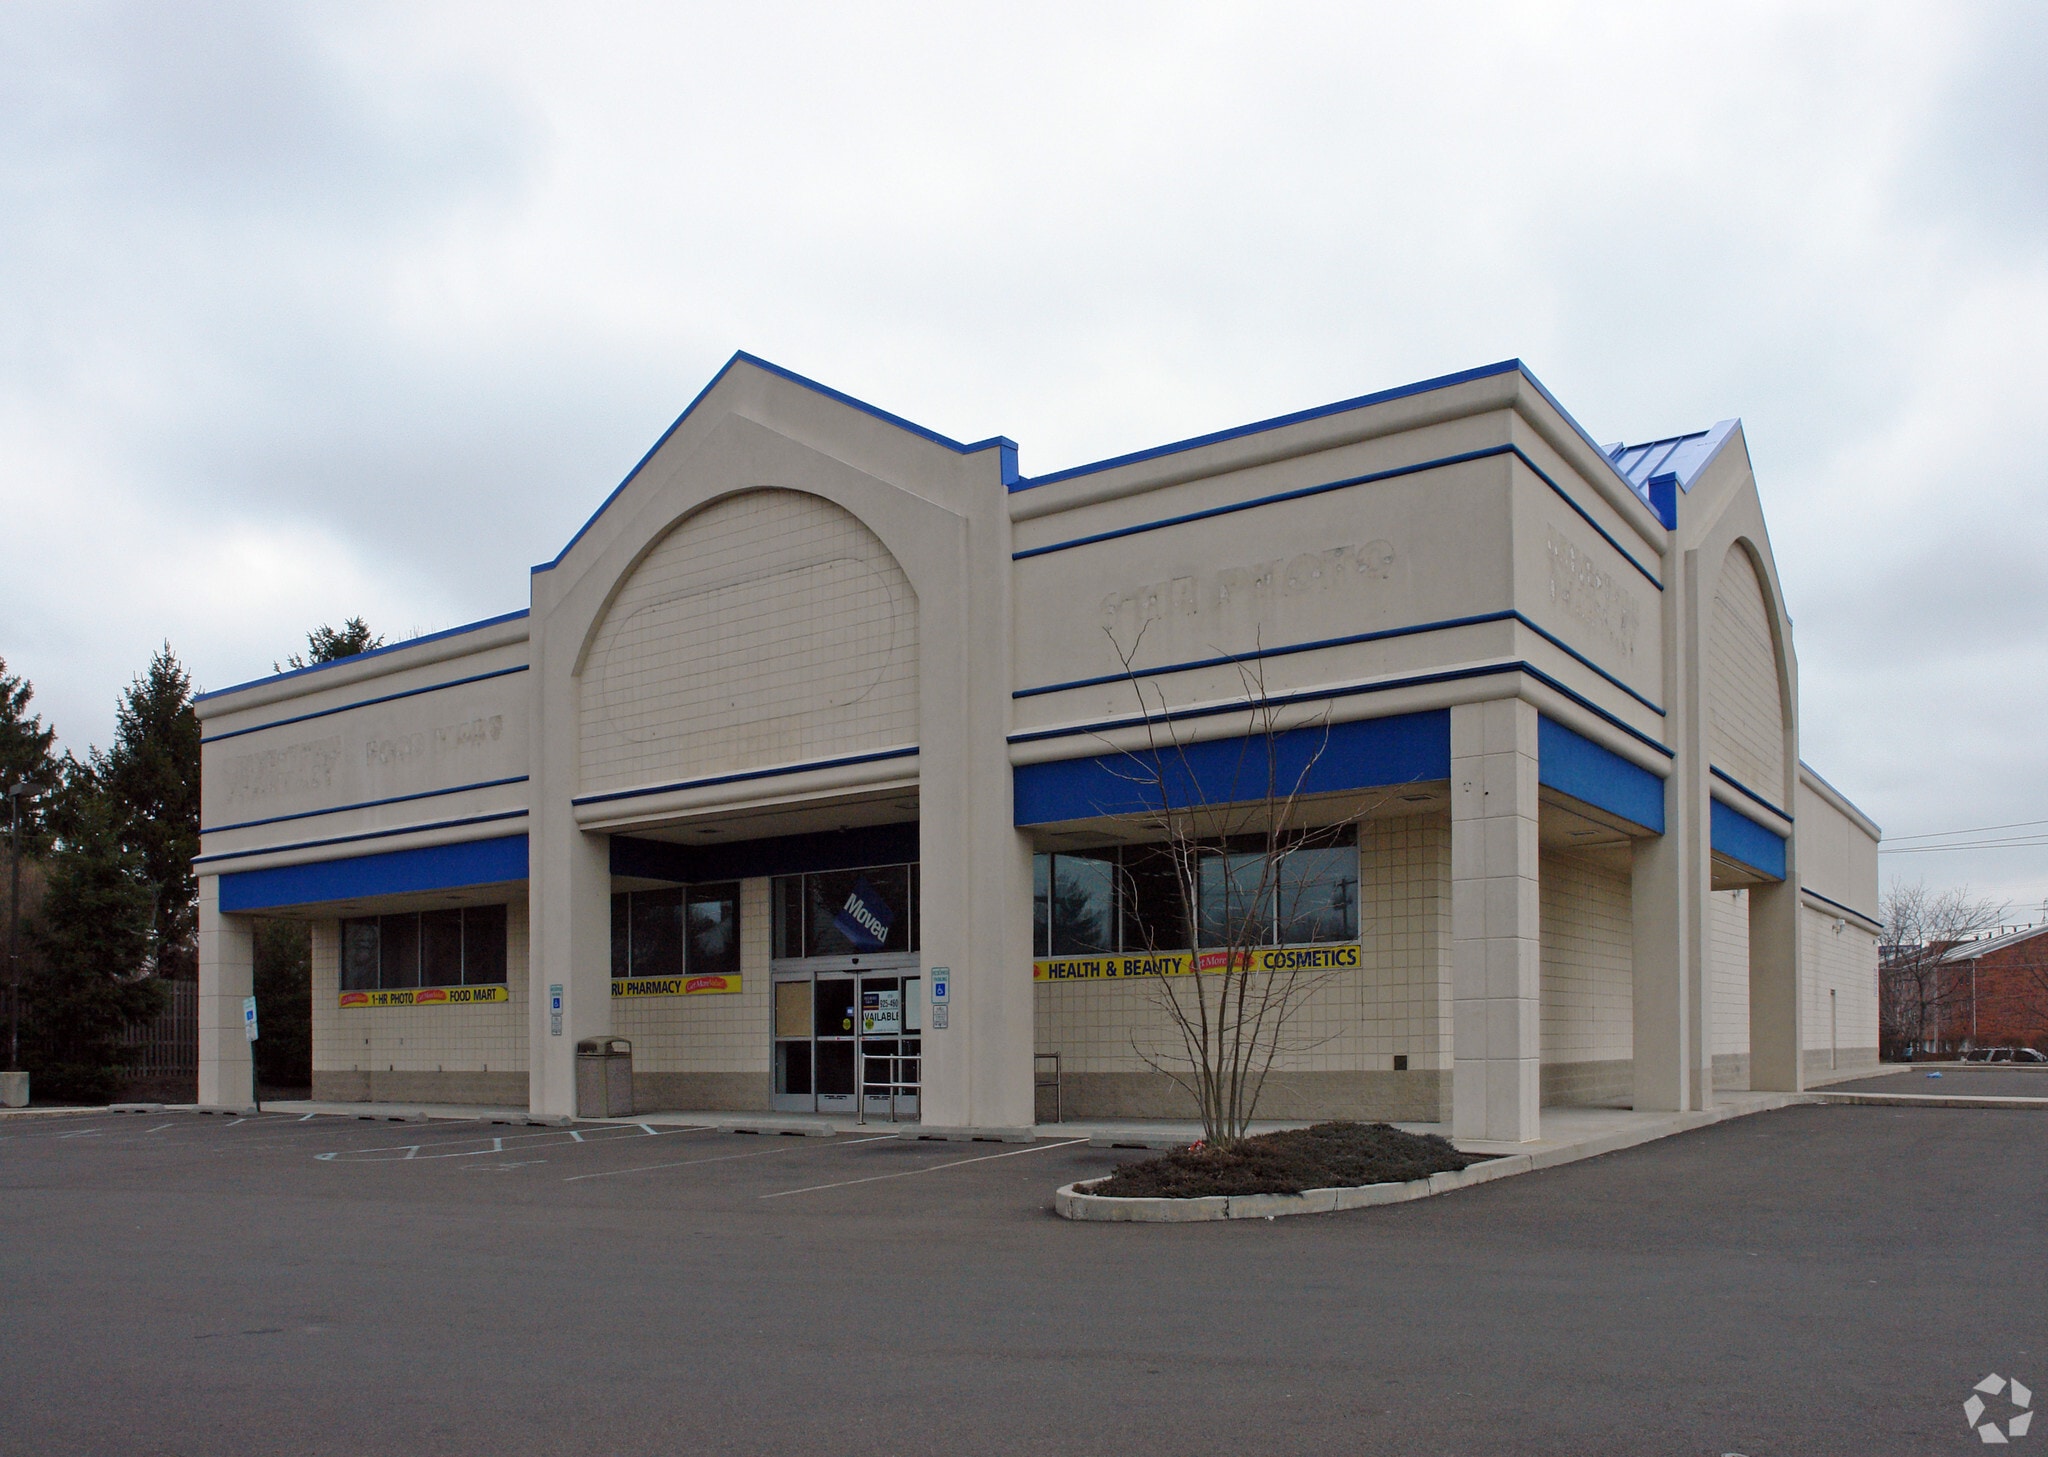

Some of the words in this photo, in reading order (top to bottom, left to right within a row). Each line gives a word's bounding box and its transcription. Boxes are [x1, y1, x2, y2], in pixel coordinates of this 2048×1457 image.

[843, 893, 889, 943] Moved
[1264, 949, 1356, 969] COSMETICS
[1049, 962, 1100, 979] HEALTH
[1106, 961, 1117, 977] &
[1123, 958, 1182, 976] BEAUTY
[450, 990, 471, 1003] FOOD
[473, 988, 497, 1001] MART
[627, 980, 682, 995] PHARMACY
[372, 994, 388, 1005] 1-HR
[390, 992, 414, 1004] PHOTO
